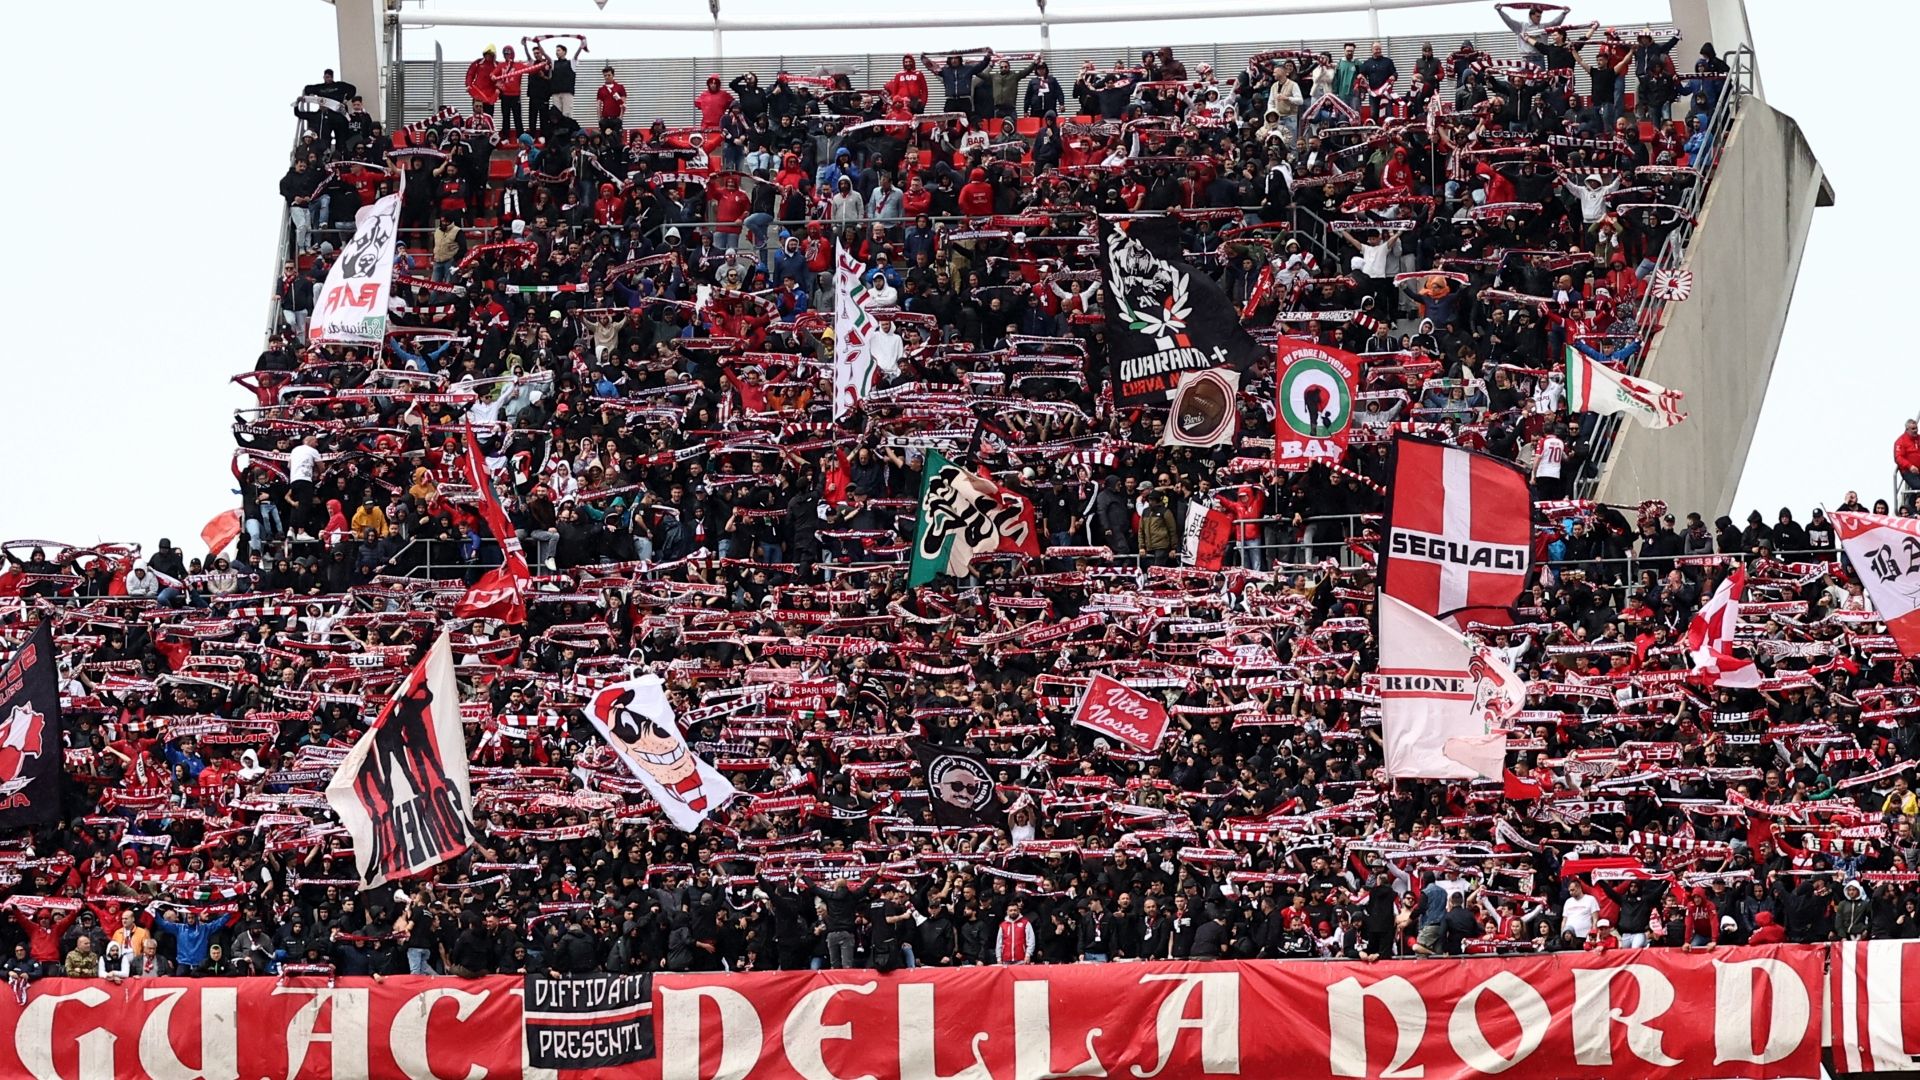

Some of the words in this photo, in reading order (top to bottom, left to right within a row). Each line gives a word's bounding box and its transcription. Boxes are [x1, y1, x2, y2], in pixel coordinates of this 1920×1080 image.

[1120, 348, 1210, 382] QUARANTA
[1122, 377, 1165, 397] CURVA
[233, 423, 269, 435] REGGIO
[1548, 445, 1562, 463] 70
[1393, 532, 1524, 571] SEGUACI
[786, 613, 808, 621] BARI
[764, 645, 828, 659] SEGUA
[1205, 655, 1239, 666] SOLO
[802, 687, 819, 695] BARI
[1385, 677, 1464, 693] RIONE
[687, 696, 752, 721] BARI
[1105, 688, 1148, 721] Vita
[1088, 704, 1149, 745] Nostra
[287, 772, 319, 782] REGGINA
[535, 973, 641, 1007] DIFFIDATI
[11, 984, 558, 1080] GUAC
[659, 971, 1240, 1080] DELLA
[1327, 958, 1811, 1080] NORD
[539, 1022, 642, 1059] PRESENTI
